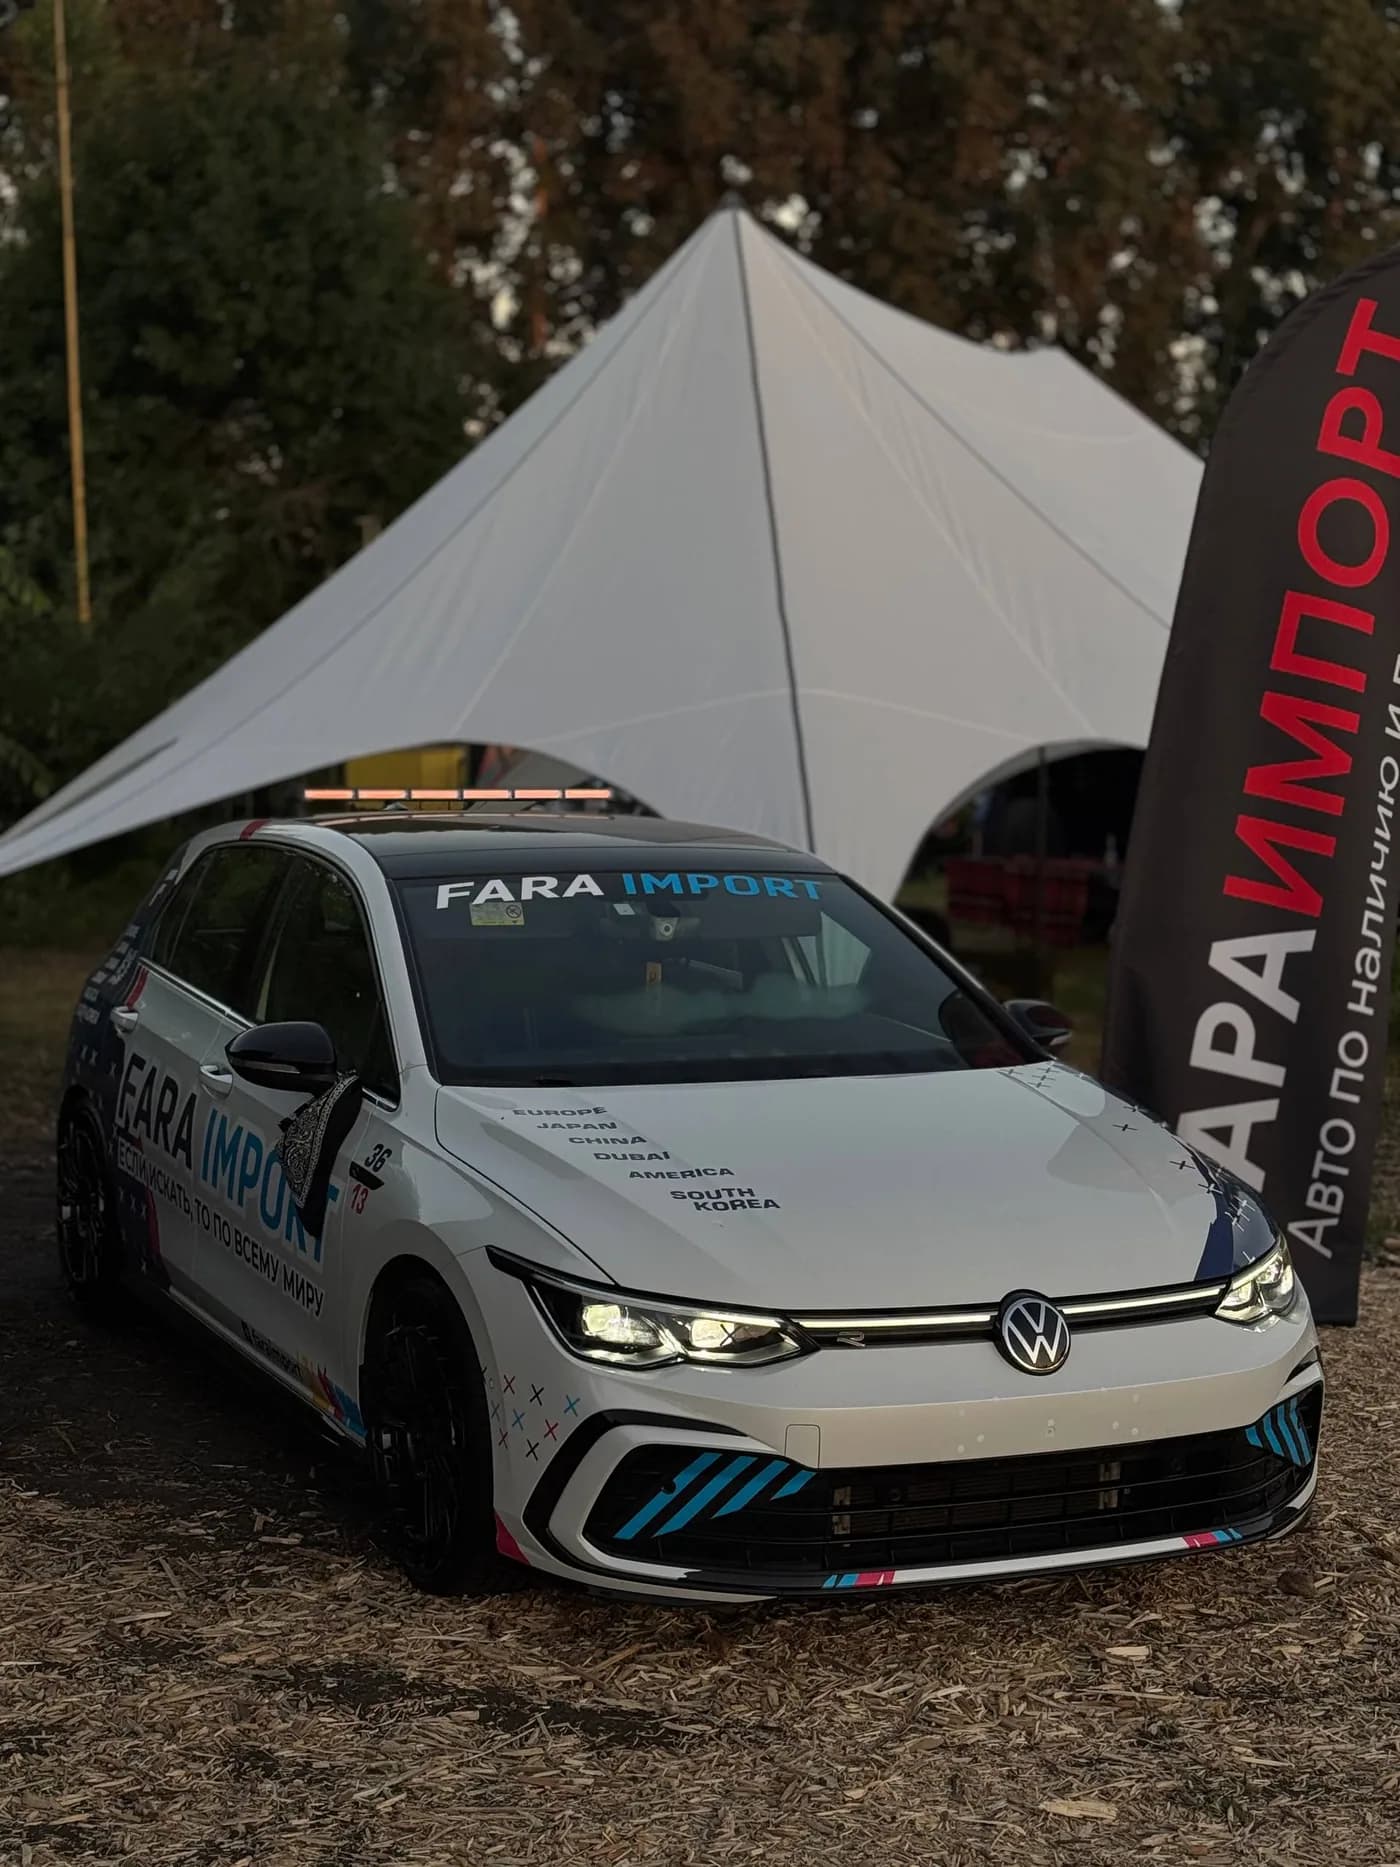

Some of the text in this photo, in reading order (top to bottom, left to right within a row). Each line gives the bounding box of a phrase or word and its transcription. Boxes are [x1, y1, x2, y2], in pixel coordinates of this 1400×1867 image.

[1177, 297, 1400, 1194] АРАИМПОРТ
[436, 872, 823, 910] FARA IMPORT
[1346, 755, 1400, 1016] наличию
[1328, 1030, 1369, 1104] по
[118, 1052, 197, 1170] FARA
[513, 1106, 608, 1117] EUROPE
[537, 1121, 617, 1130] JAPAN
[568, 1135, 648, 1145] CHINA
[364, 1143, 393, 1173] 36
[593, 1151, 671, 1161] DUBAI
[628, 1168, 735, 1180] AMERICA
[1286, 1117, 1356, 1259] Авто
[351, 1183, 369, 1215] 13
[669, 1188, 756, 1201] SOUTH
[693, 1199, 781, 1212] KOREA
[194, 1198, 210, 1231] ТО
[213, 1212, 231, 1247] ПО
[234, 1228, 279, 1282] ВСЕМУ
[283, 1263, 323, 1317] МИРУ
